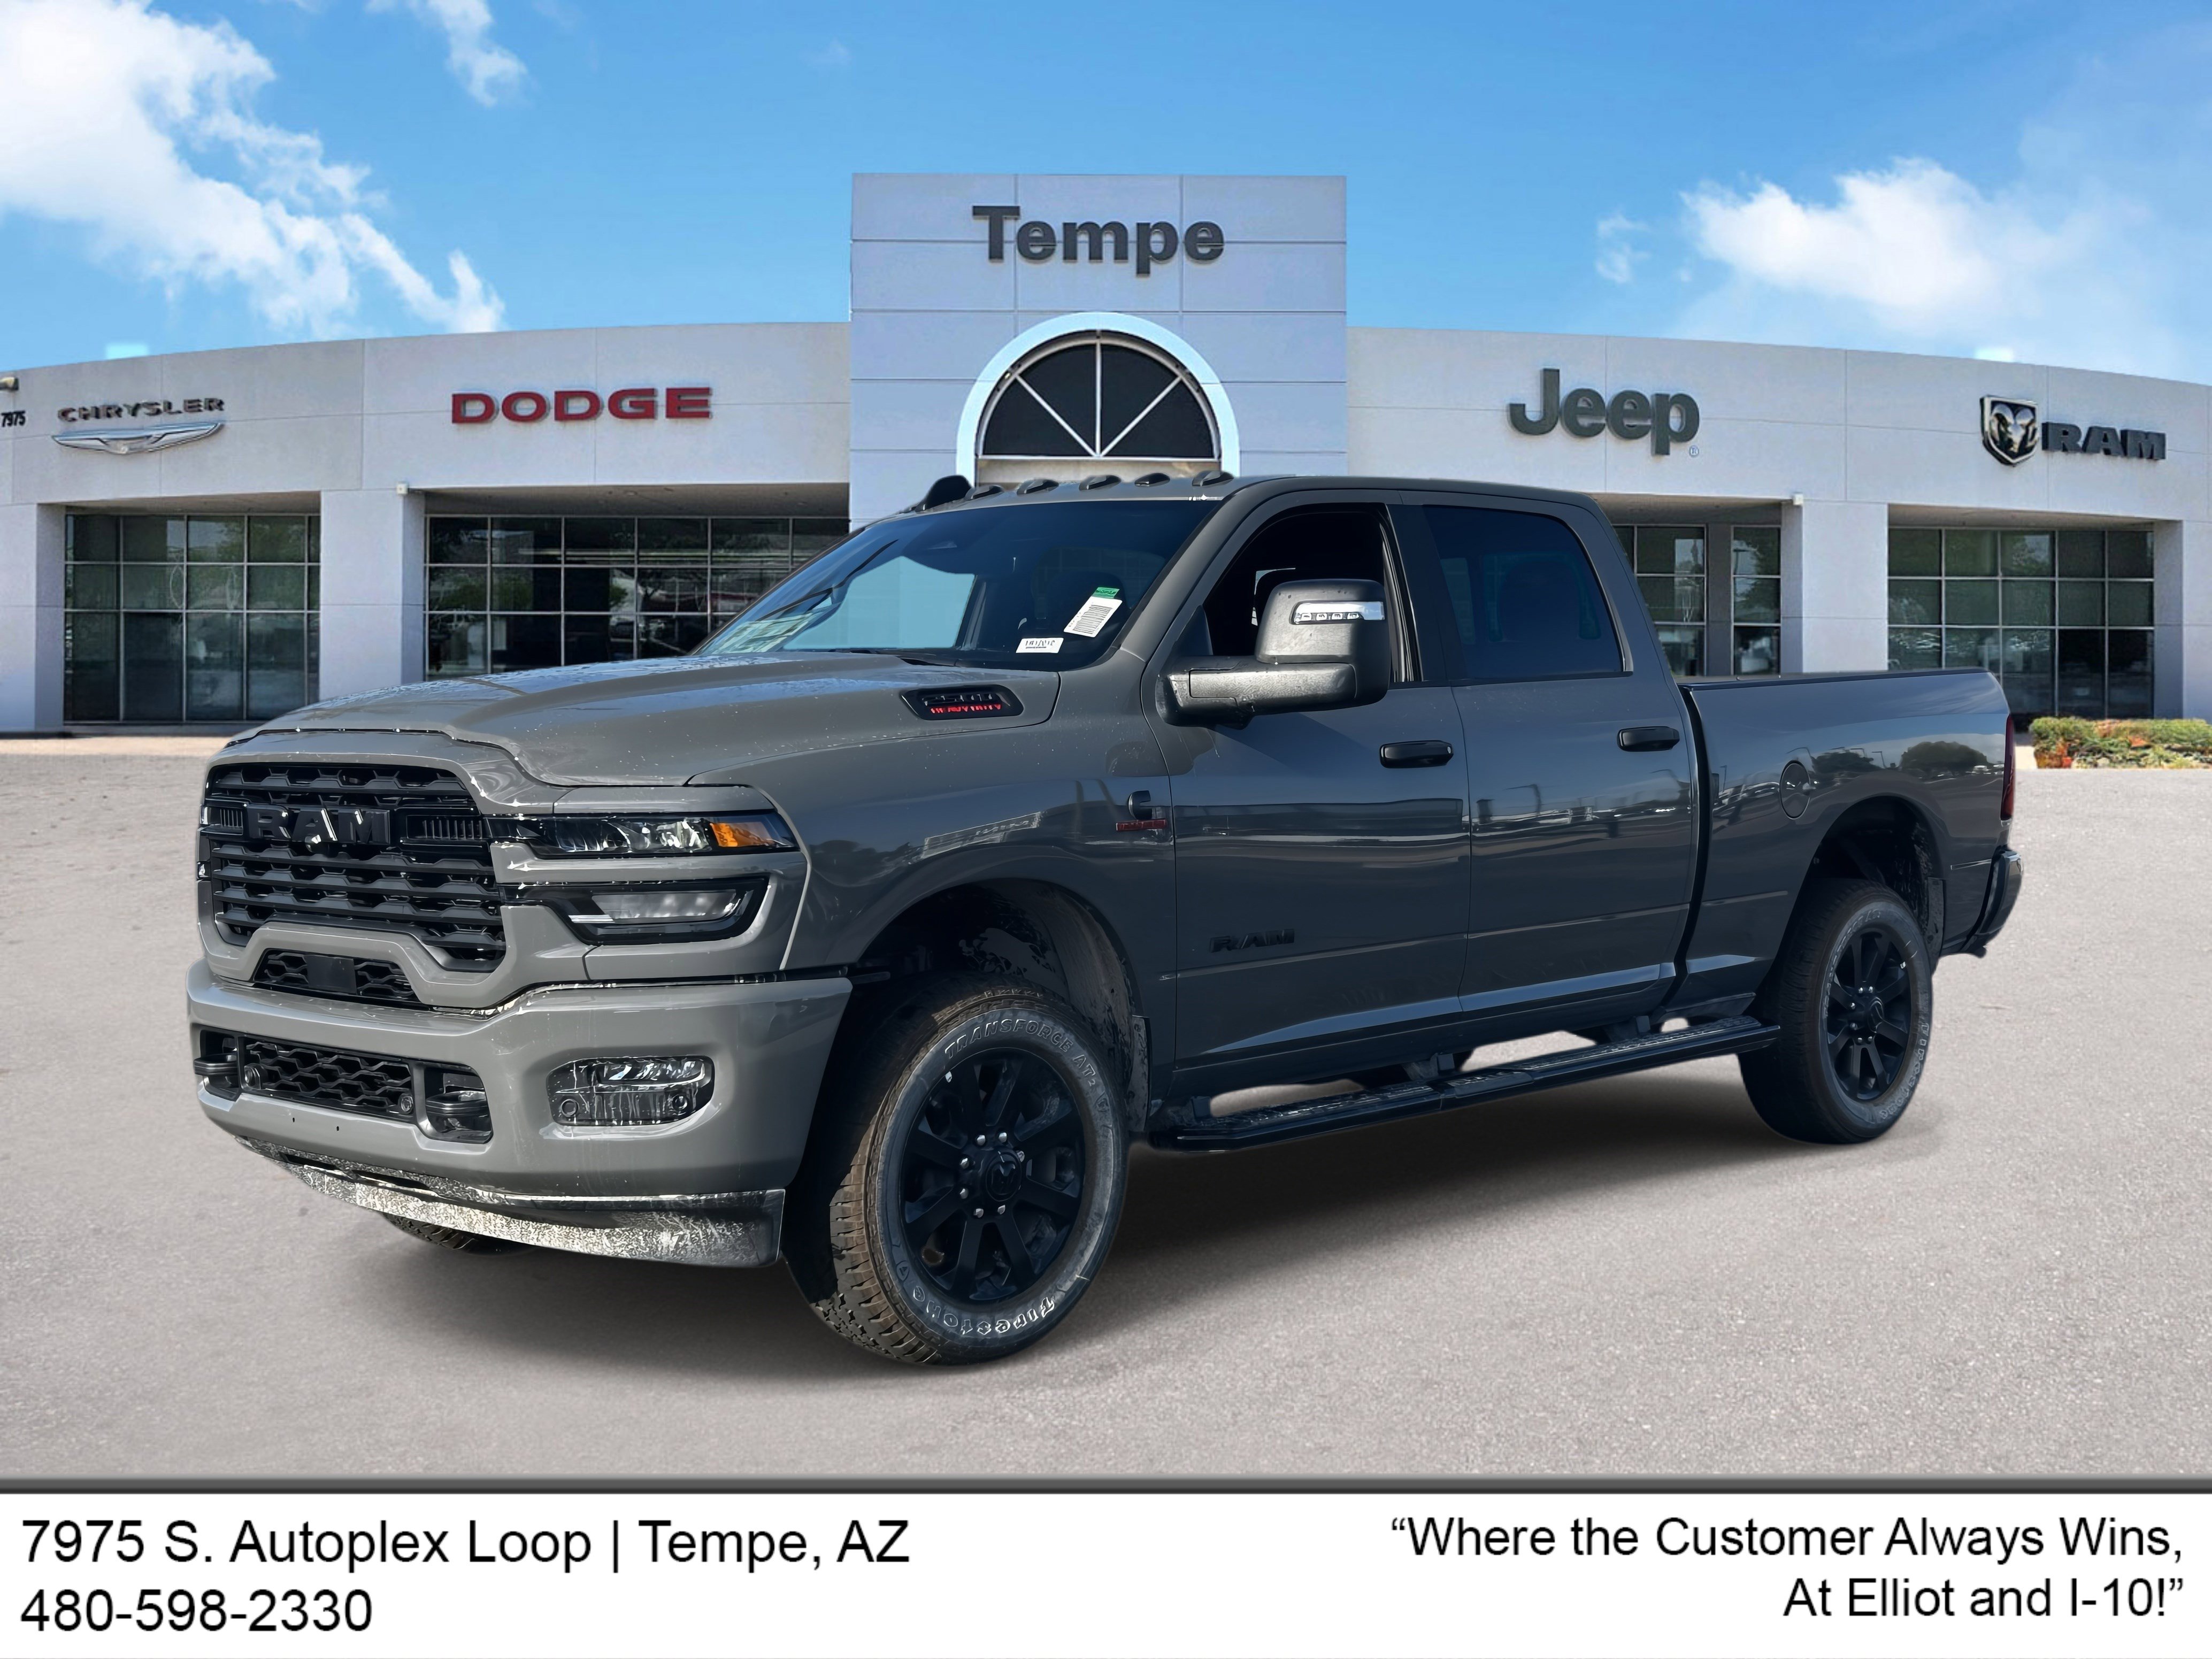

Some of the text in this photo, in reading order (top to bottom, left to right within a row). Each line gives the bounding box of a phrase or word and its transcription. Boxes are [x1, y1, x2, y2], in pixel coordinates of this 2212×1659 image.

[972, 205, 1225, 278] Tempe
[1, 410, 26, 427] 7975
[57, 397, 225, 423] CHRYSLER
[451, 387, 713, 424] DODGE
[1508, 368, 1700, 456] Jeep
[2041, 421, 2166, 460] RAM
[248, 804, 391, 845] RAM
[1210, 928, 1295, 953] RAM
[944, 1018, 1073, 1059] TRANSFORCE
[912, 1285, 1056, 1335] Firestone
